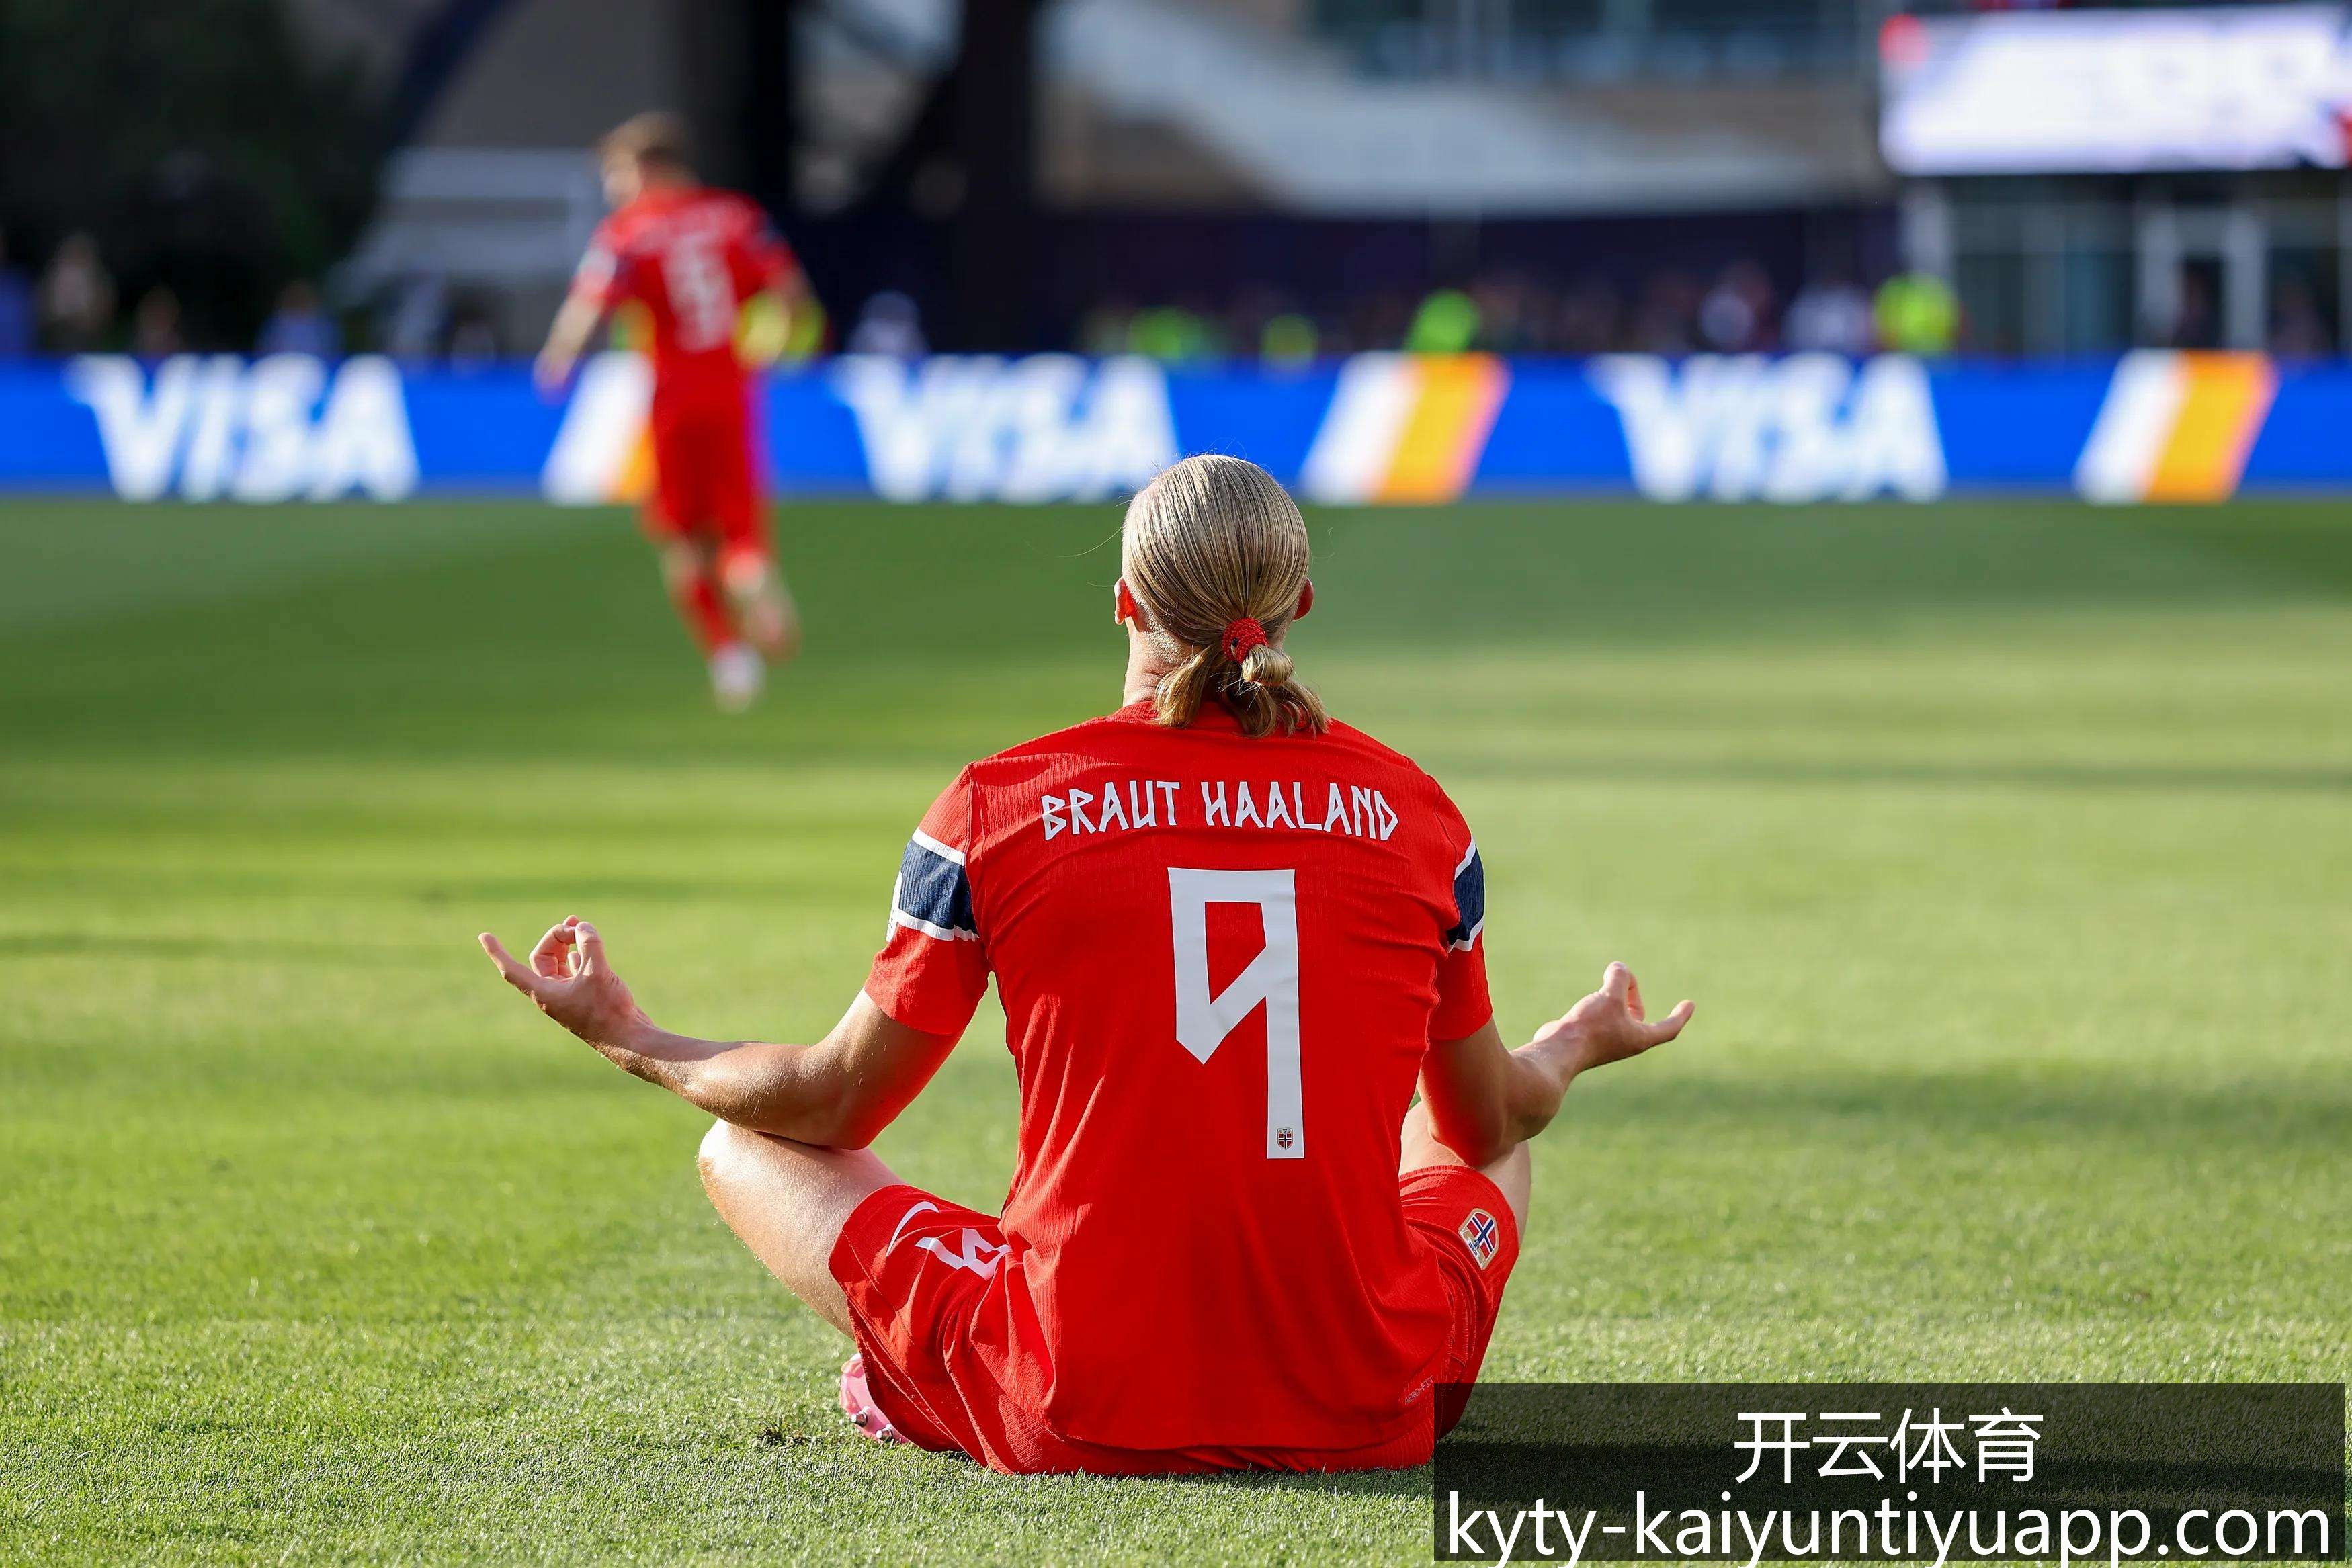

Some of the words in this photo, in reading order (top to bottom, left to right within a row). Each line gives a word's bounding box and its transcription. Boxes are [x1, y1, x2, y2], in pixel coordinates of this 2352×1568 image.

[66, 355, 419, 503] VISA
[833, 355, 1179, 503] VISA
[1589, 354, 1948, 503] VISA
[1041, 780, 1180, 841] BRAUT
[1201, 781, 1398, 841] HAALAND
[1167, 867, 1304, 1159] 9
